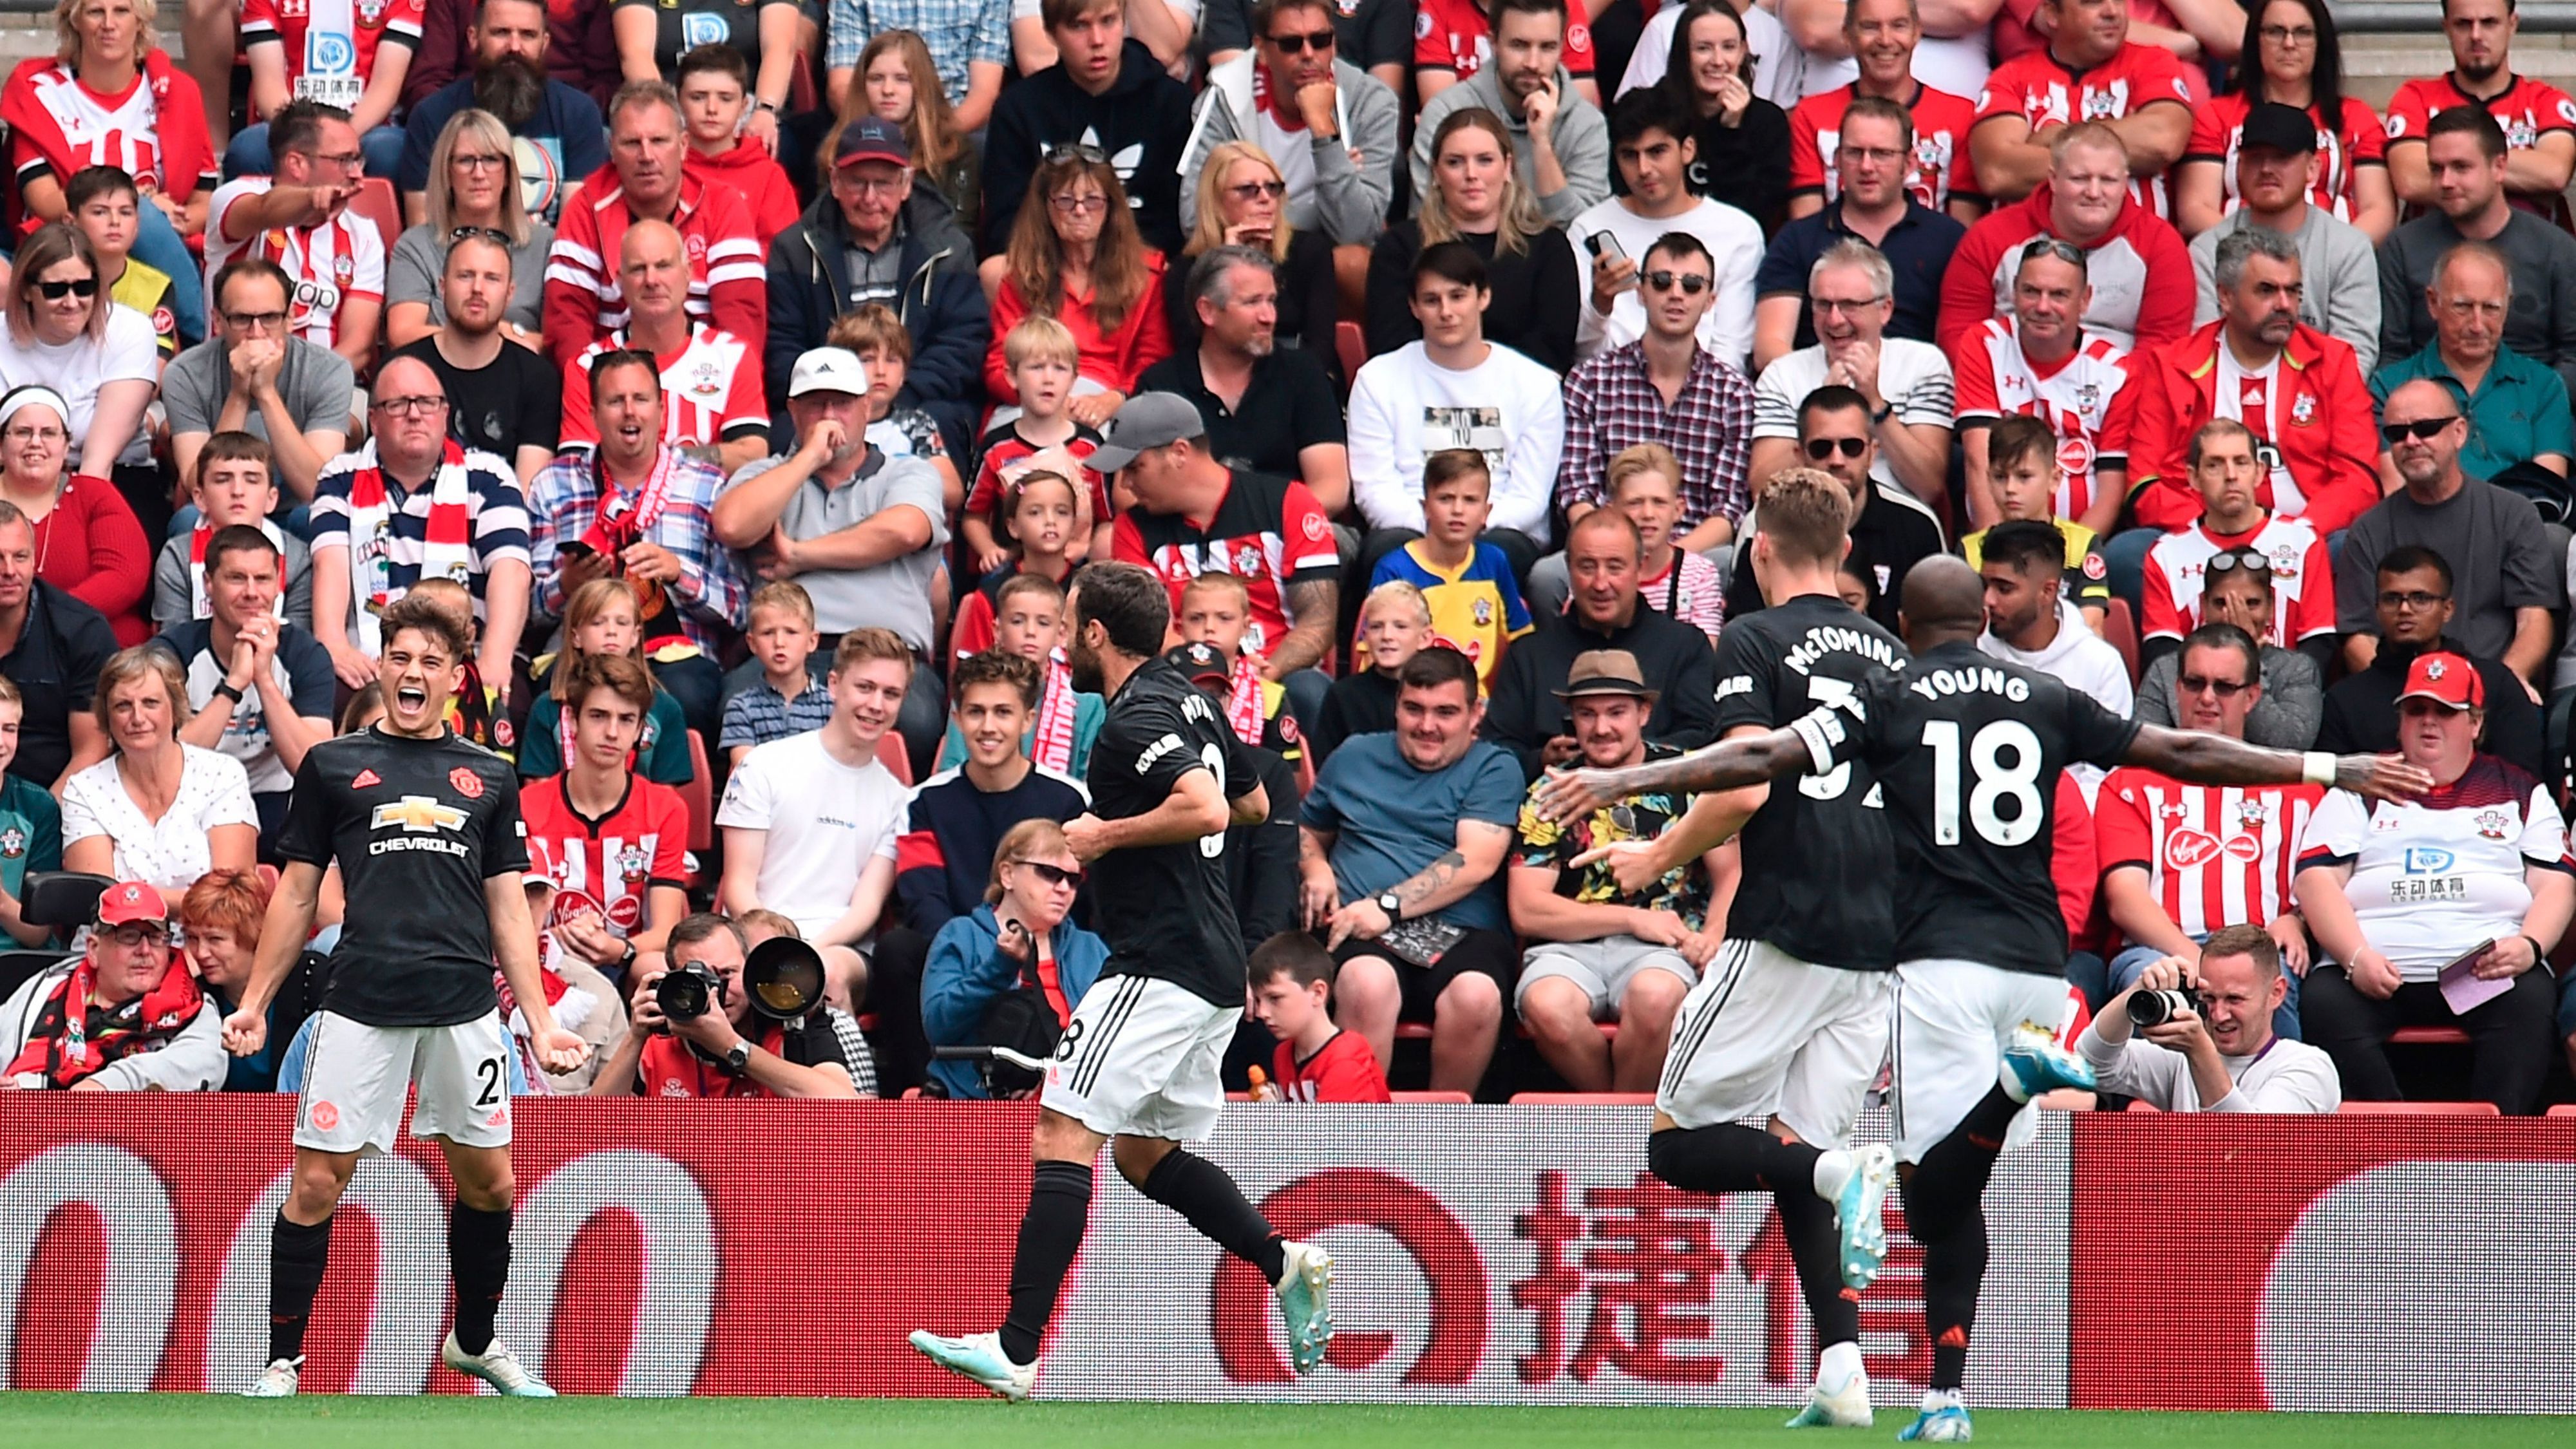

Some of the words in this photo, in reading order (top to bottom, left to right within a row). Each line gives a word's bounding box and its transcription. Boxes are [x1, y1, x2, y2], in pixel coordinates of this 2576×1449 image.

[1910, 667, 2030, 702] YOUNG
[1922, 719, 2044, 847] 18
[369, 837, 469, 858] CHEVROLET
[2391, 878, 2464, 896] 乐动体育
[1056, 1018, 1084, 1063] 8
